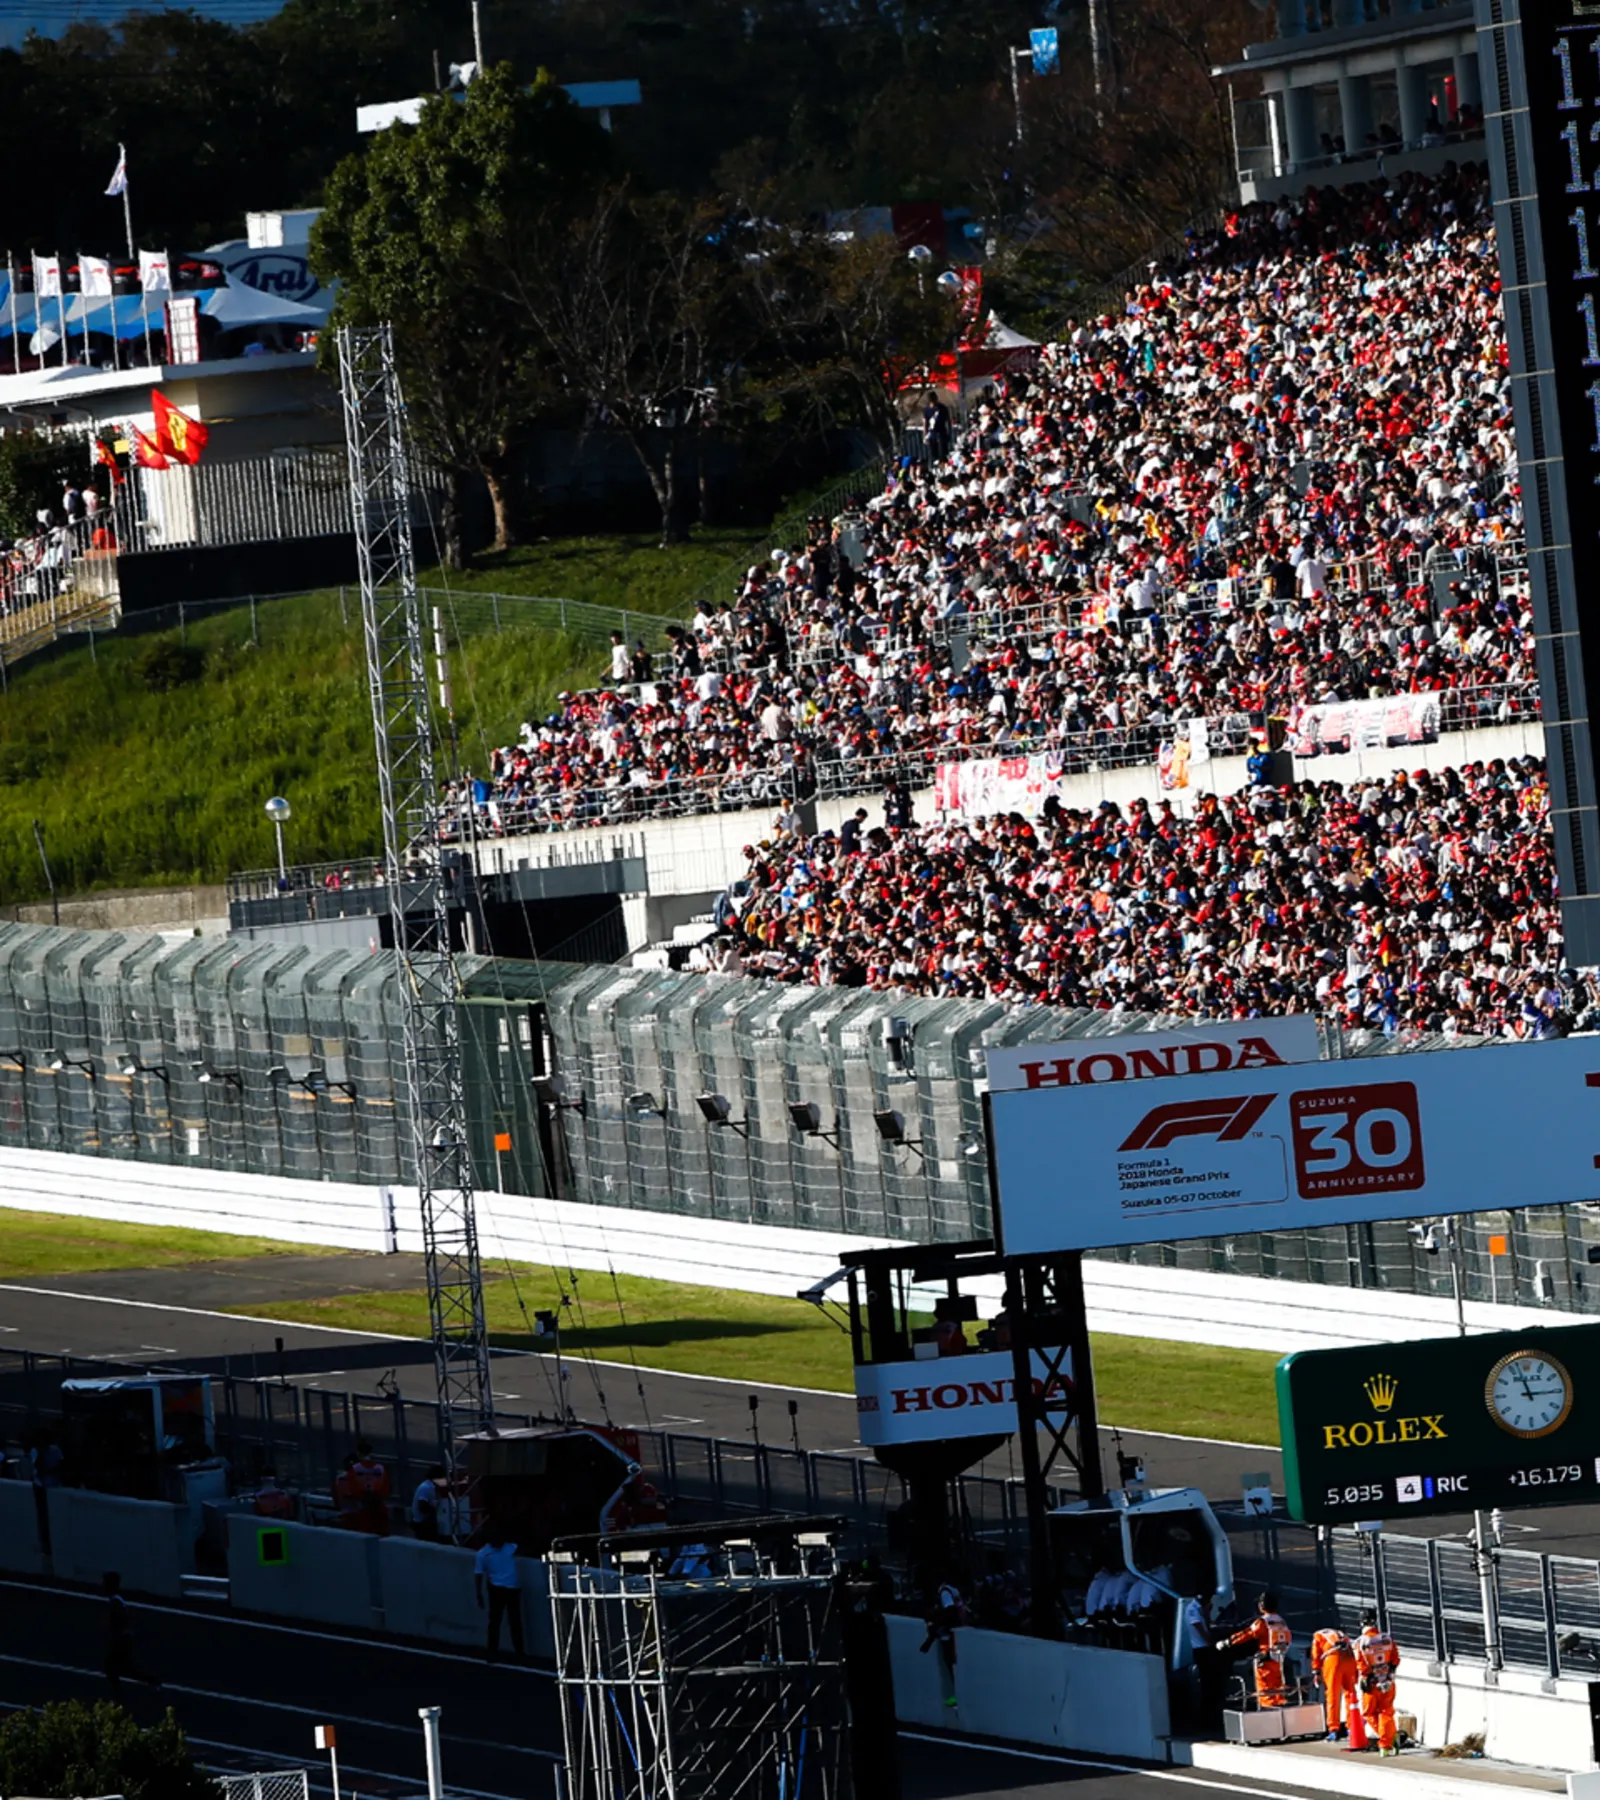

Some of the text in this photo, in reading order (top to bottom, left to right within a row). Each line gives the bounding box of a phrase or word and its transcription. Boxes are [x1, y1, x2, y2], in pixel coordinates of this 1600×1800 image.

[1019, 1036, 1288, 1089] HONDA
[1298, 1096, 1357, 1109] SUZUKA
[1299, 1107, 1413, 1174] 30
[1117, 1157, 1170, 1172] Formula 1
[1118, 1166, 1184, 1182] 2018 Honda
[1119, 1170, 1231, 1190] Japanese Grand Prix
[1307, 1172, 1416, 1190] ANNIVERSARY
[1120, 1189, 1243, 1209] Suzuka 05-07 October
[1323, 1415, 1448, 1449] ROLEX
[1324, 1484, 1384, 1505] 5.035
[1403, 1483, 1416, 1496] 4
[1437, 1475, 1469, 1494] RIC
[1508, 1465, 1582, 1487] +16.179
